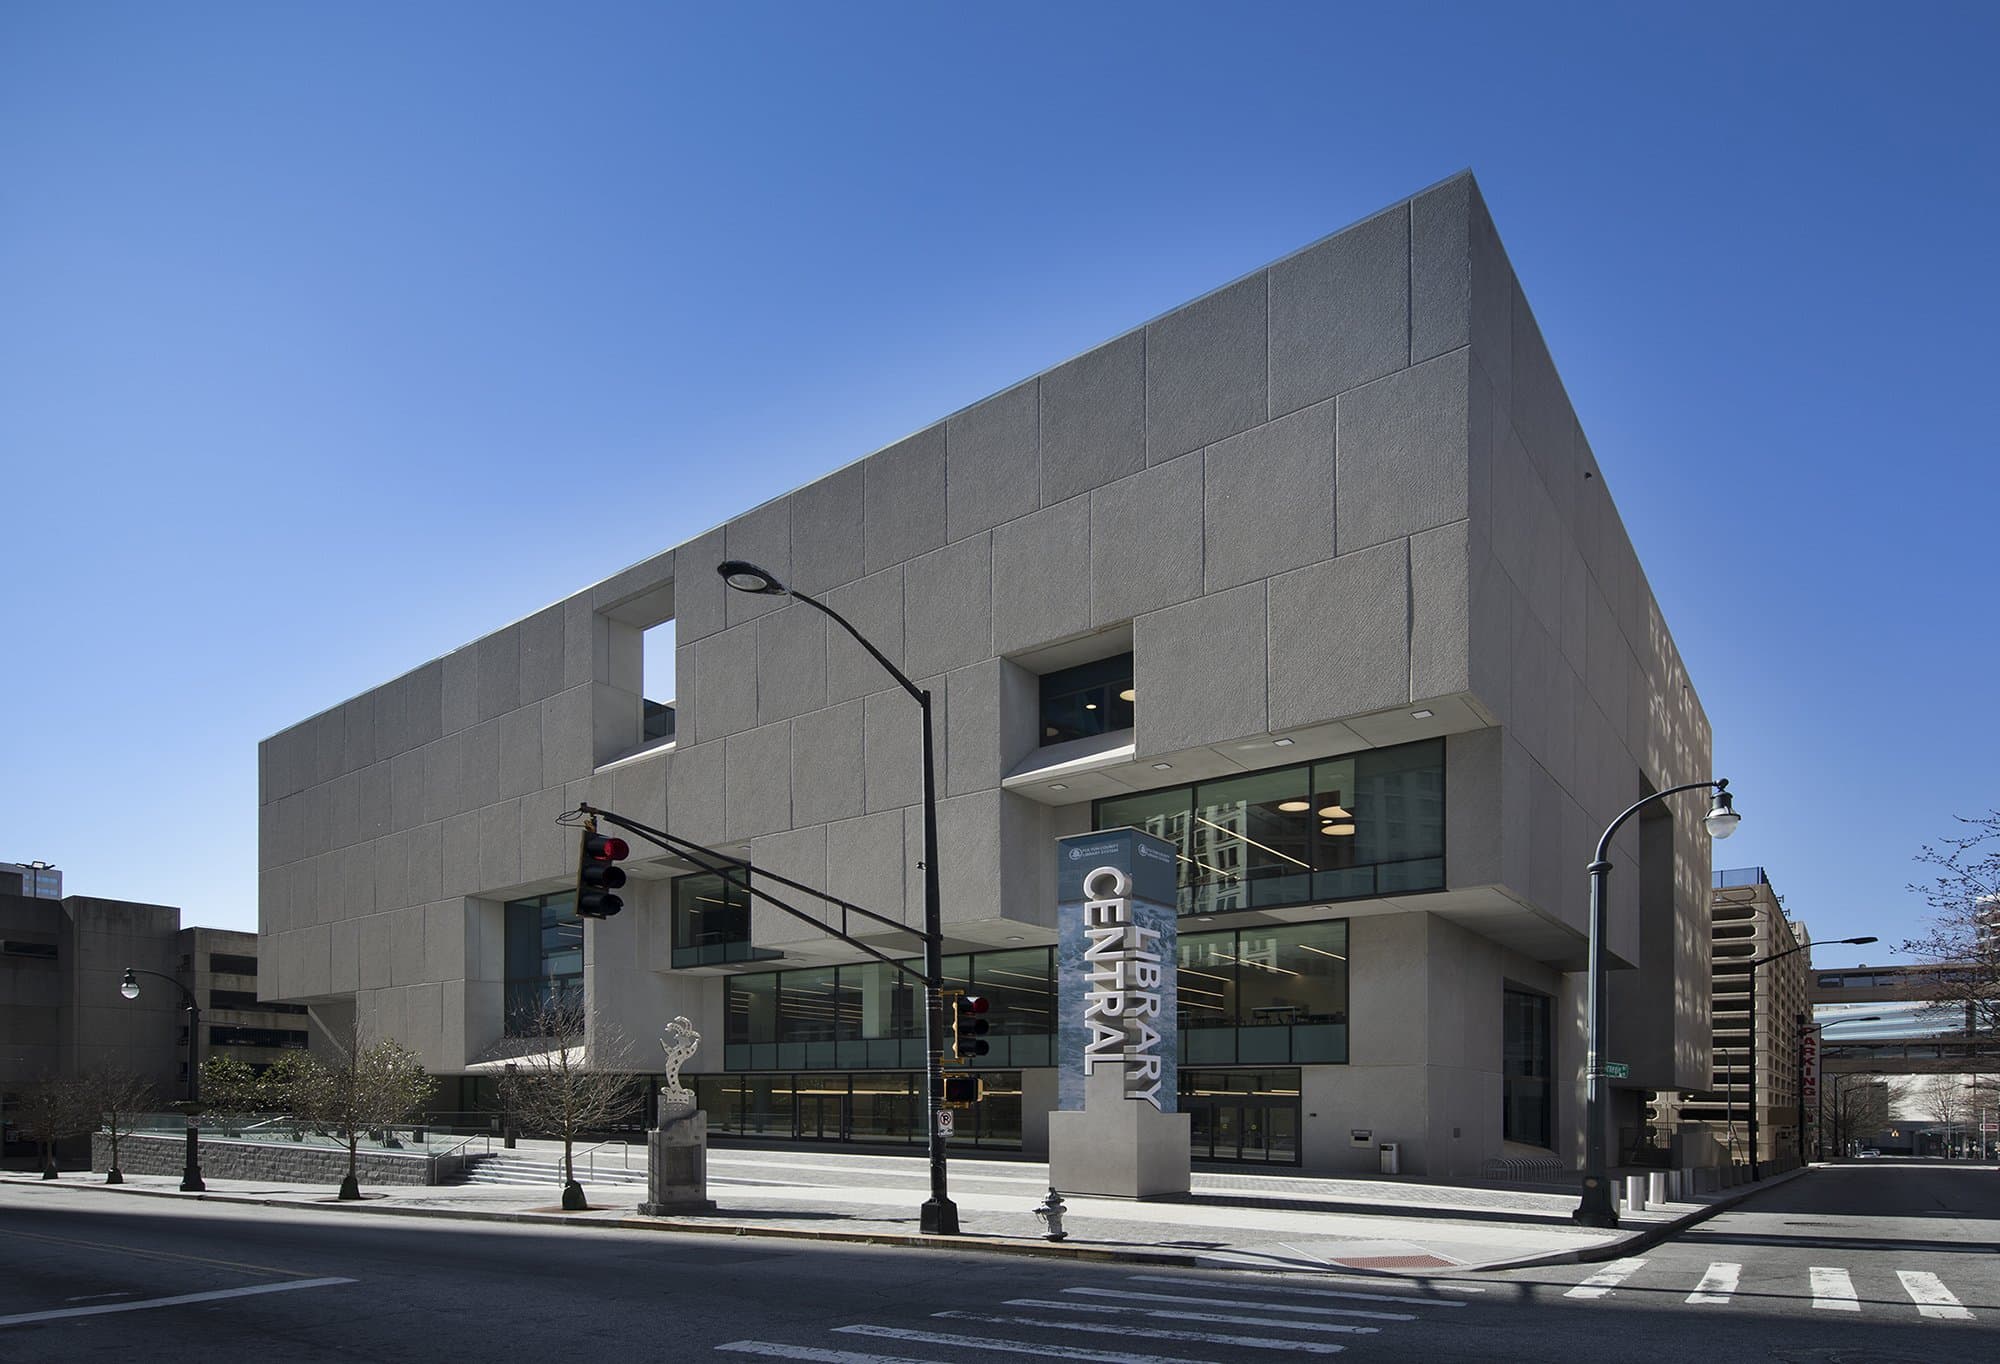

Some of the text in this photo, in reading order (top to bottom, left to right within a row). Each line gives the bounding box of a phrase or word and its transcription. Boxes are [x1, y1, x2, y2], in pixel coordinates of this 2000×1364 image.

[1083, 866, 1125, 1076] CENTRAL
[1135, 925, 1162, 1111] LIBRARY
[1803, 1027, 1817, 1097] PARKING
